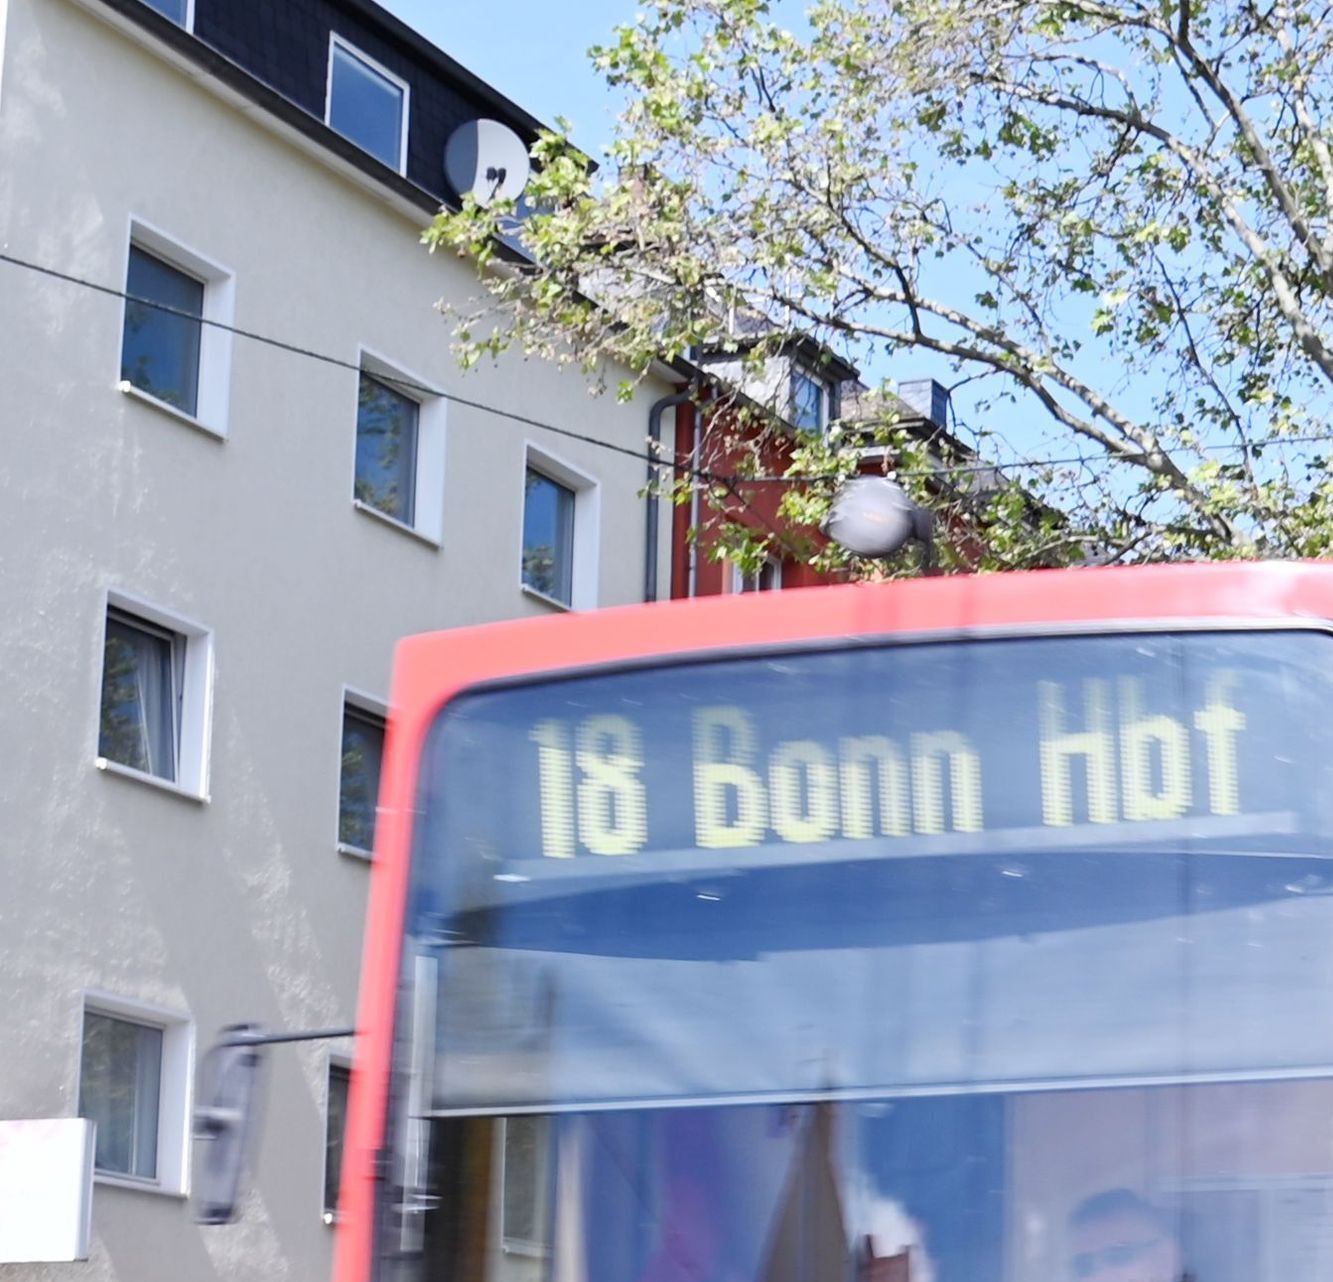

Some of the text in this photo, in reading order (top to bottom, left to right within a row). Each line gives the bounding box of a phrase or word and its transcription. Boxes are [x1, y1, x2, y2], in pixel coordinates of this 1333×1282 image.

[529, 674, 1246, 859] 18 Bonn Hbf
